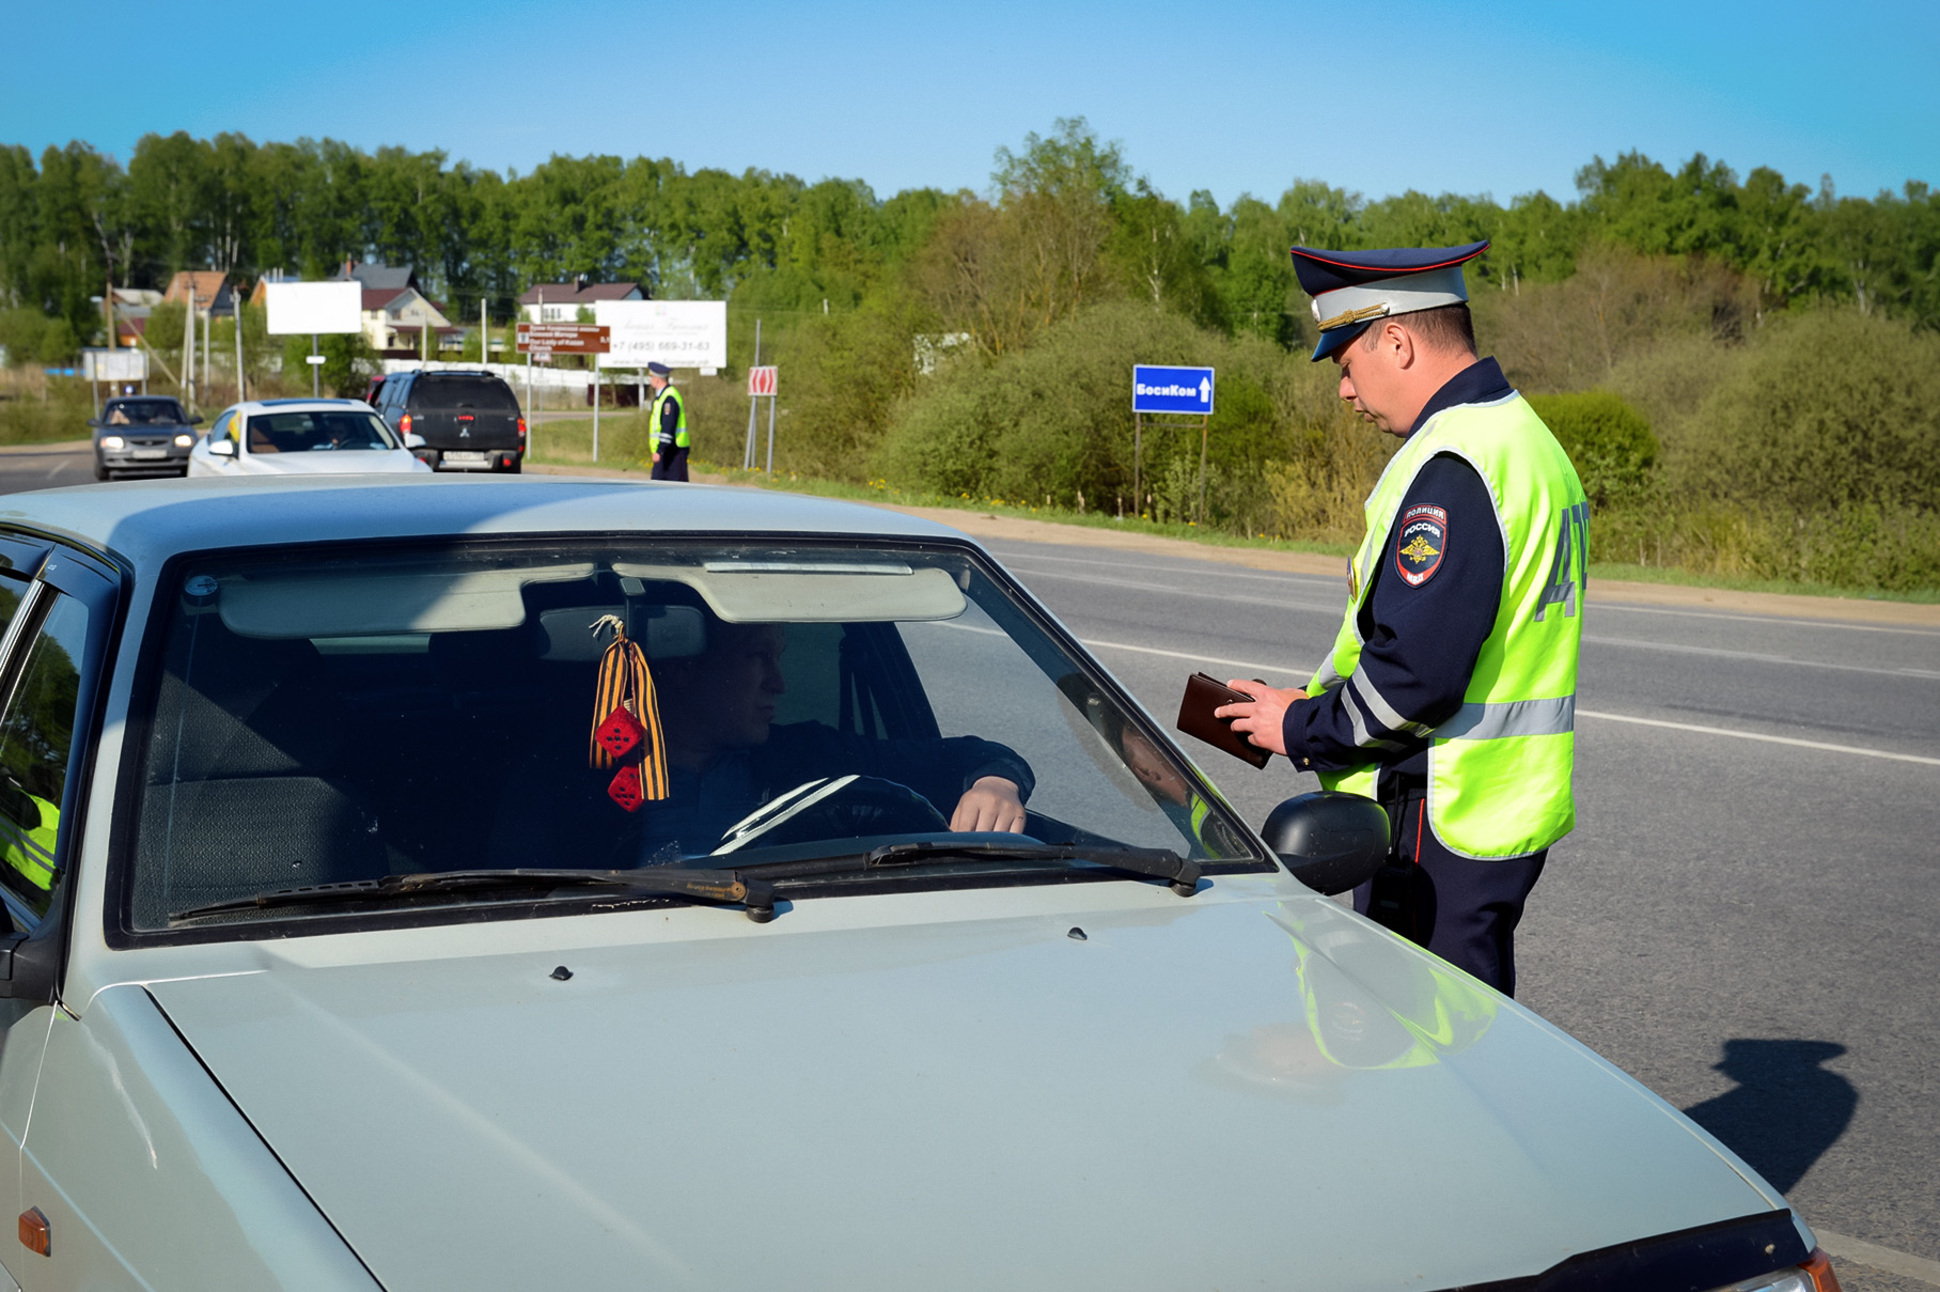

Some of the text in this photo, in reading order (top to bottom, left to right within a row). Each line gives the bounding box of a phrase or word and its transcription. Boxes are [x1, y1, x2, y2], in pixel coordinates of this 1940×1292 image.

[628, 341, 655, 353] (495)
[1406, 507, 1444, 519] ПОЛИЦИЯ
[1404, 522, 1440, 538] РОССИЯ
[1406, 573, 1424, 584] МВД
